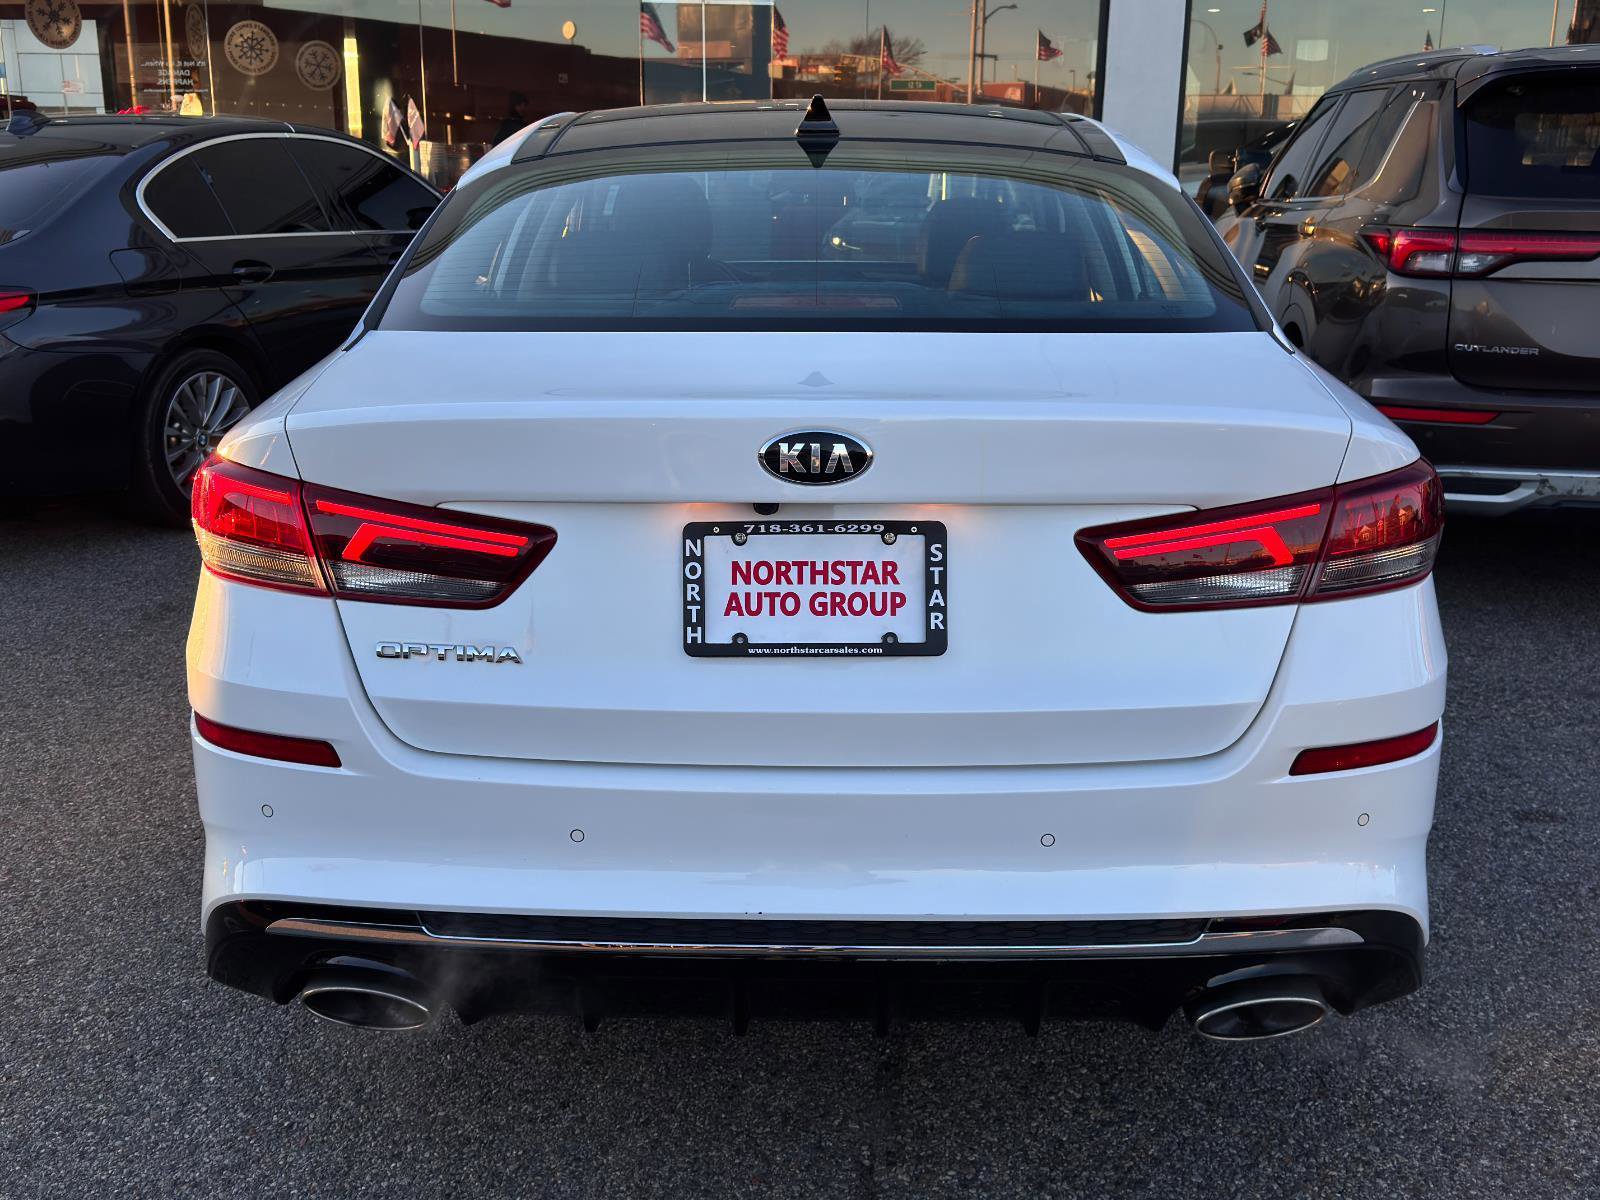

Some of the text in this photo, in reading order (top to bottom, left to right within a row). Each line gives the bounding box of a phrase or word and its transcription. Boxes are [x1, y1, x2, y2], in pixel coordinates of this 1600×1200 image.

[1455, 344, 1539, 355] OUTLANDER
[779, 443, 853, 473] KIA
[744, 524, 885, 533] 718-361-6299
[731, 561, 900, 585] NORTHSTAR
[685, 539, 702, 643] NORTH
[929, 544, 945, 630] STAR
[724, 592, 907, 616] AUTO GROUP
[375, 641, 523, 664] OPTIMA
